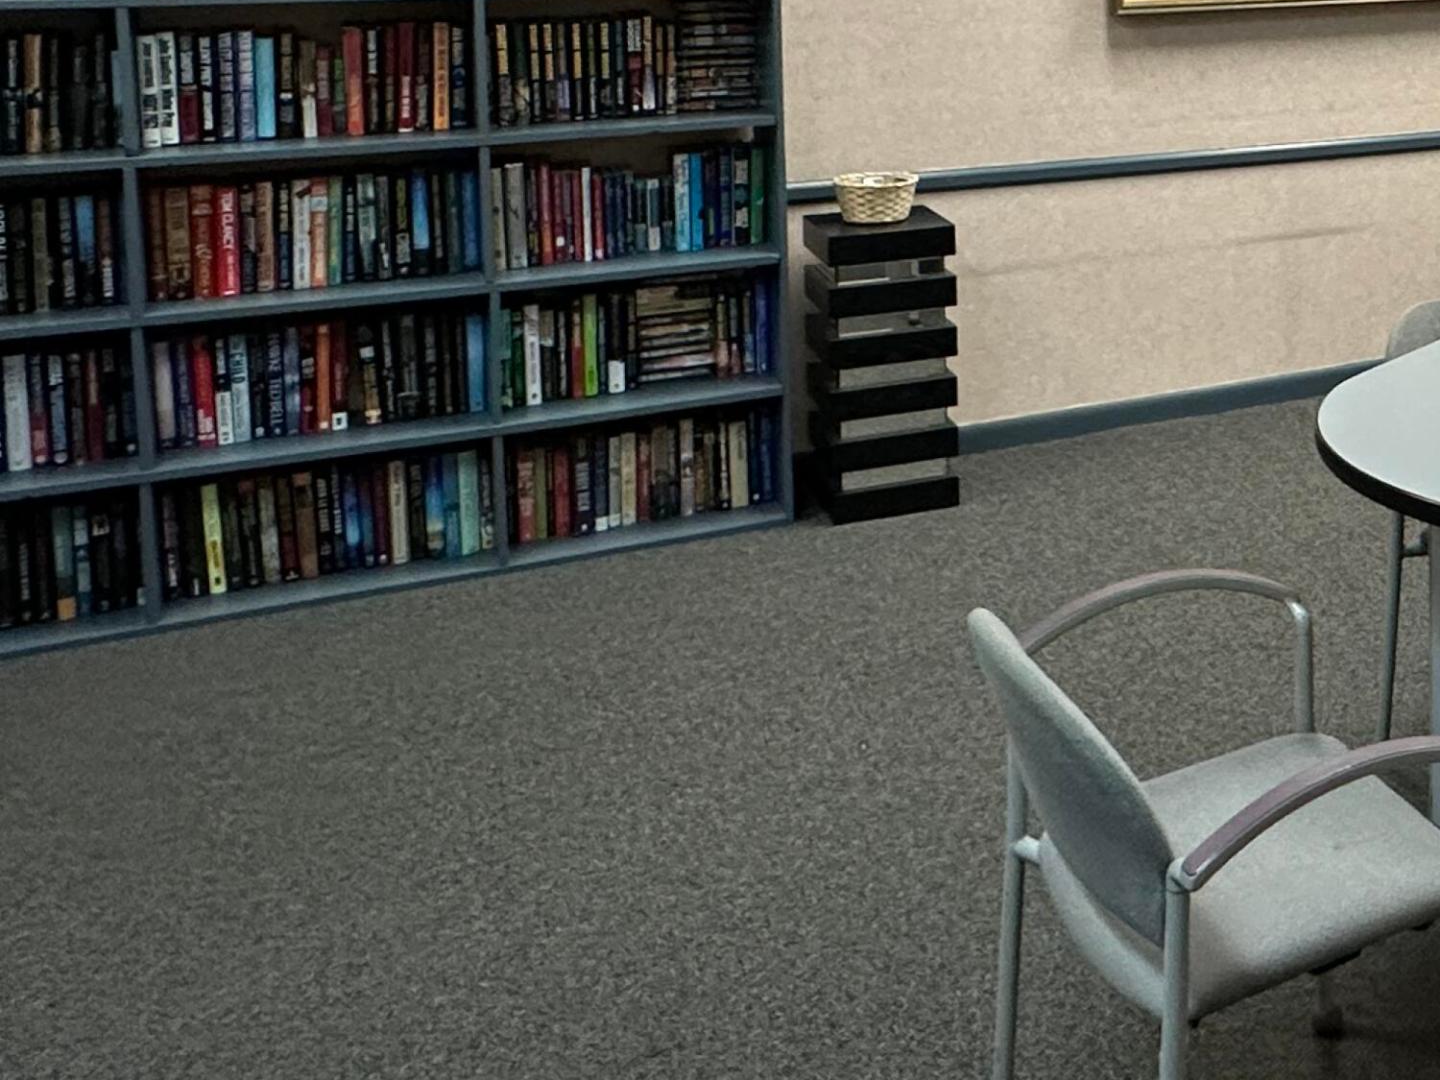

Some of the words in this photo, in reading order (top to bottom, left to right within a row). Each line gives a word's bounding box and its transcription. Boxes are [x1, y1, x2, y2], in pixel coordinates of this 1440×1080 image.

[221, 192, 233, 211] TOM
[222, 213, 235, 249] CLANCY
[230, 352, 245, 384] CHILD
